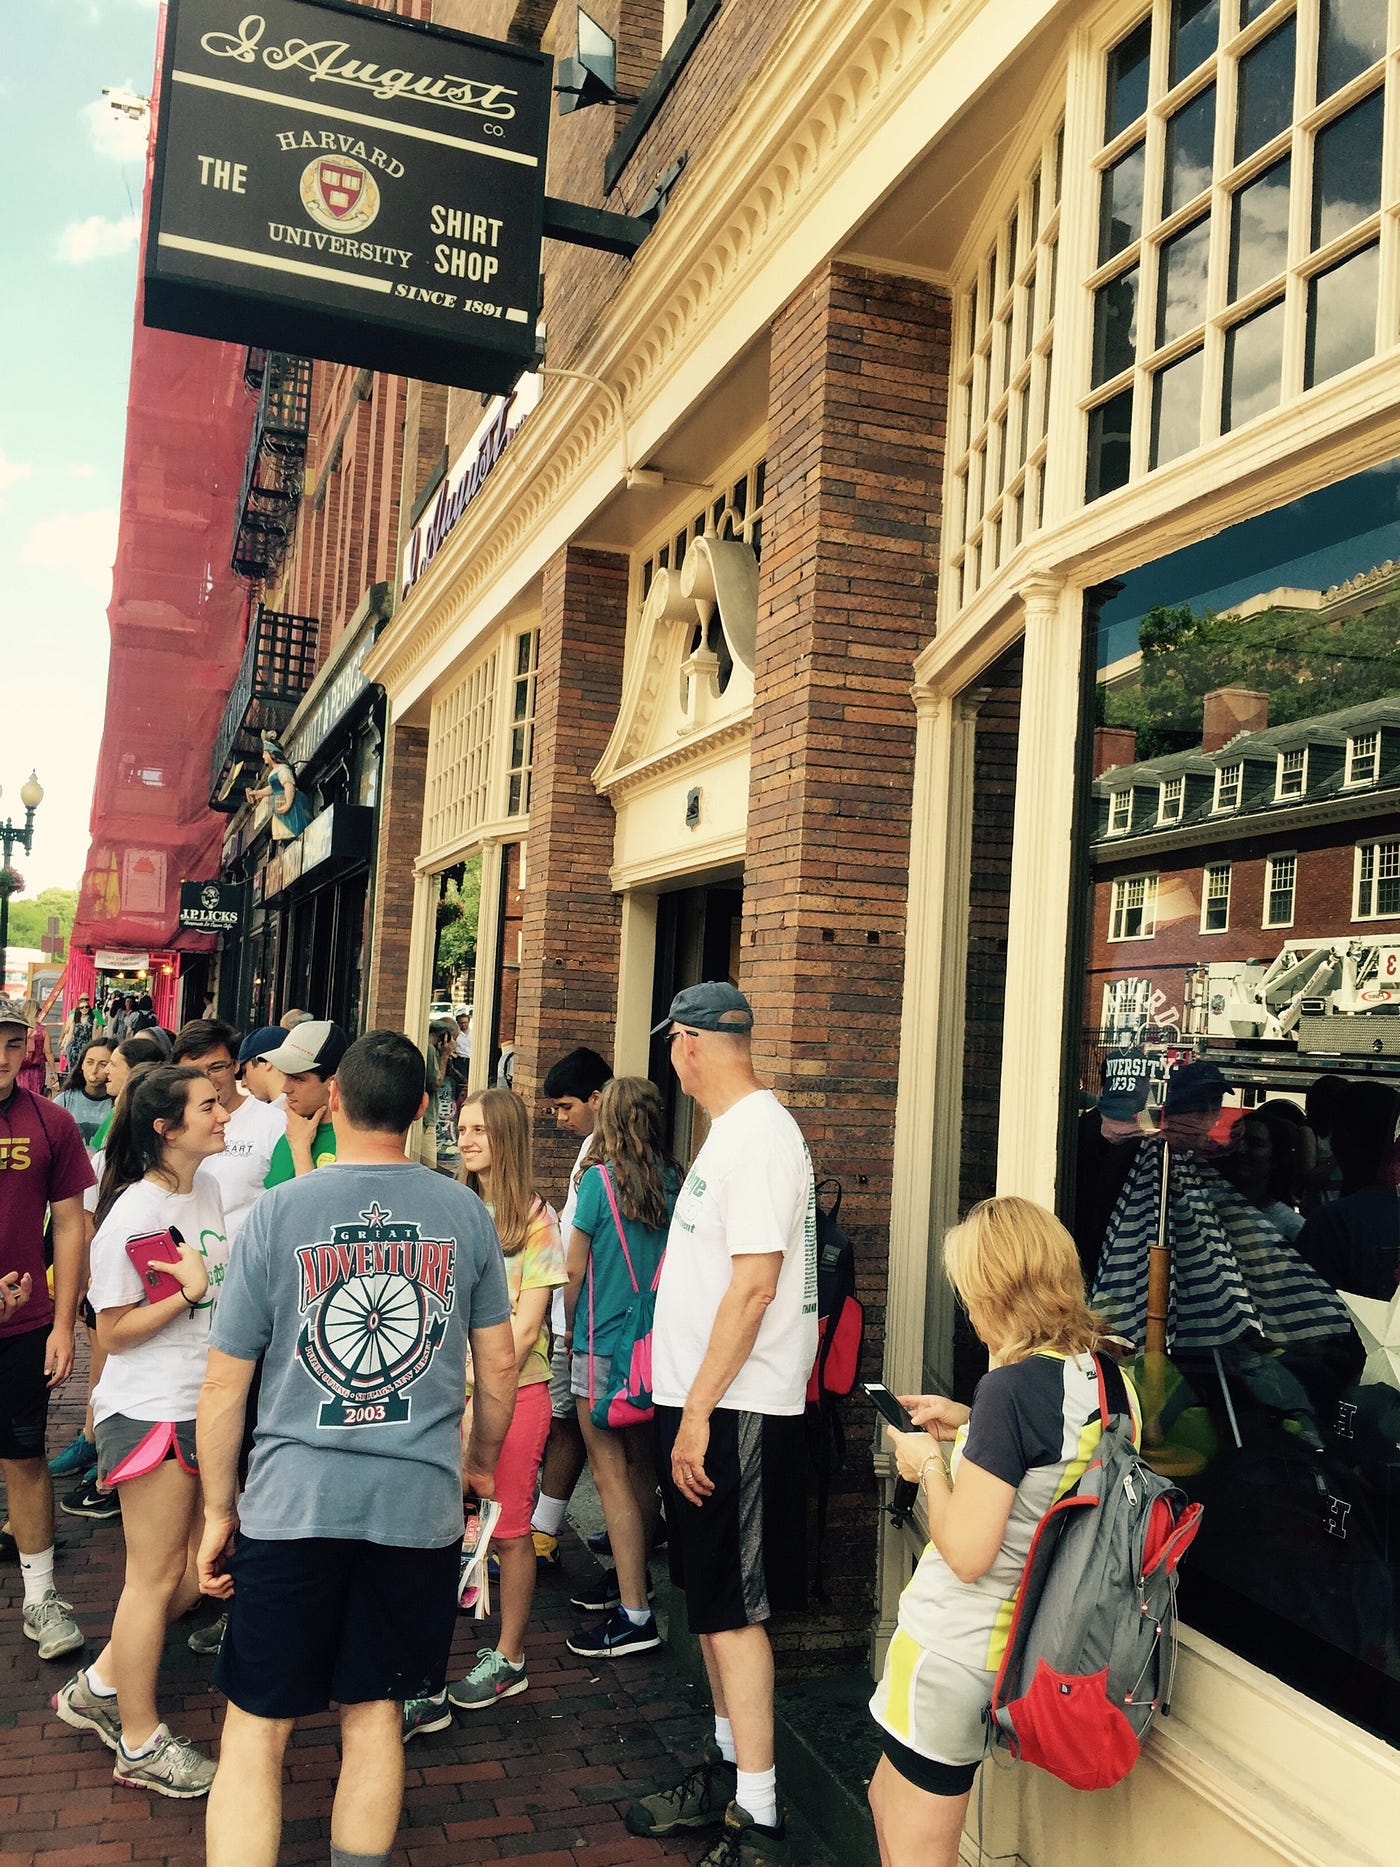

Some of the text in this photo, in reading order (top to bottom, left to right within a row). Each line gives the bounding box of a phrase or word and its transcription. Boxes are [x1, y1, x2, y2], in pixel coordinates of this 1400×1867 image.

[262, 38, 518, 120] August
[483, 123, 506, 138] CO.
[276, 130, 405, 179] HARVARD
[198, 155, 248, 194] THE
[268, 222, 413, 269] UNIVERSITY
[430, 204, 504, 248] SHIRT
[434, 243, 499, 284] SHOP
[395, 283, 503, 318] SINCE 1891
[225, 1144, 253, 1153] EART
[340, 1229, 412, 1240] GREAT
[299, 1240, 457, 1309] ADVENTURE
[393, 1370, 413, 1388] NEW
[344, 1406, 386, 1423] 2003
